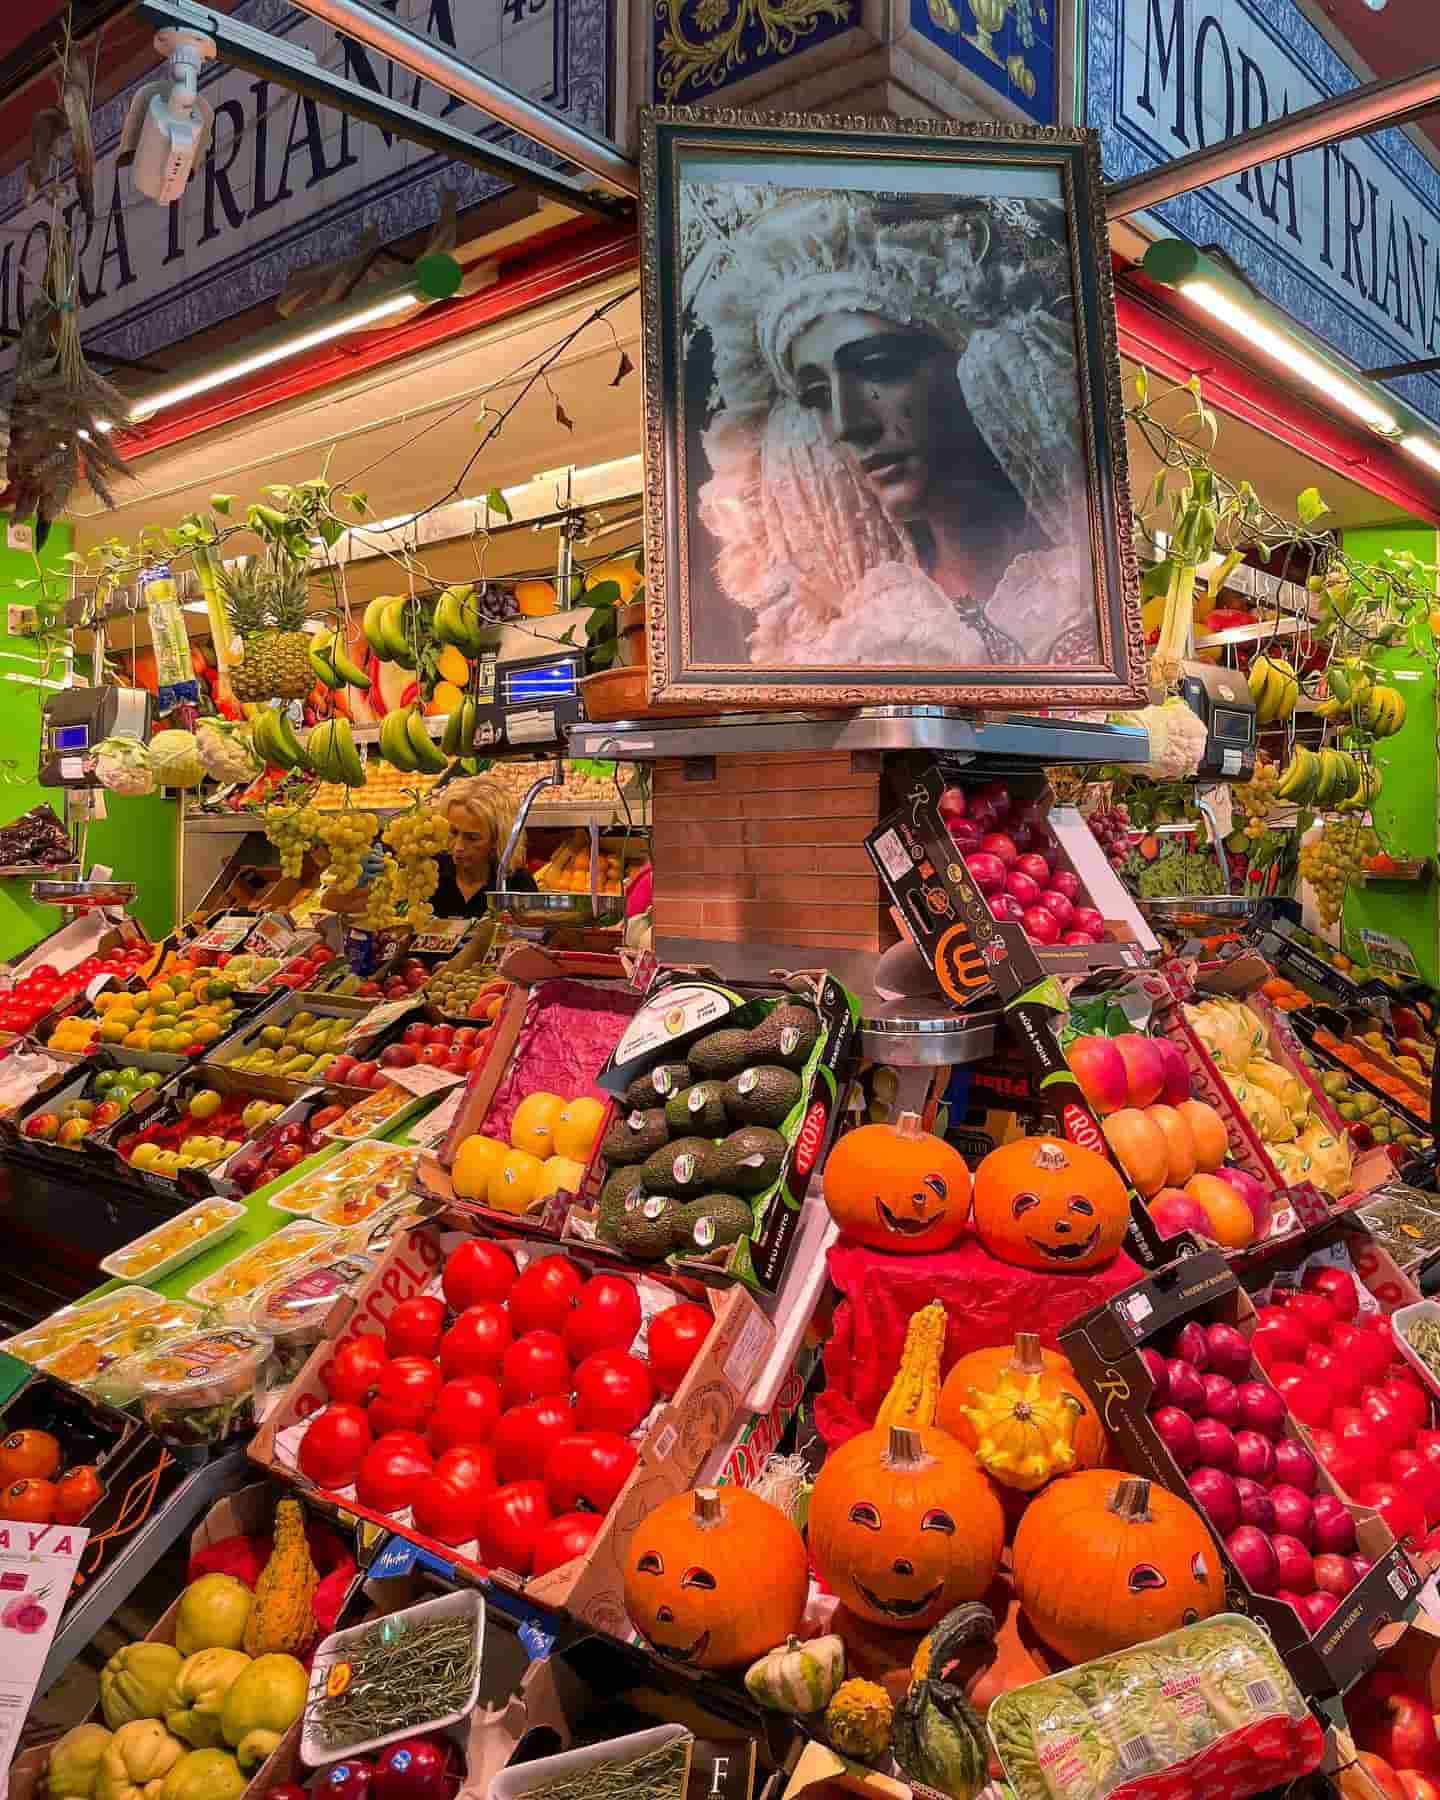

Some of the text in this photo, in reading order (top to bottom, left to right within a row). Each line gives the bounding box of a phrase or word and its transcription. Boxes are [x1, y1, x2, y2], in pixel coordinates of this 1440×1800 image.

[1137, 0, 1302, 244] MORA
[1031, 1038, 1053, 1068] POINT
[798, 1103, 826, 1174] TROPS
[710, 1757, 729, 1792] F
